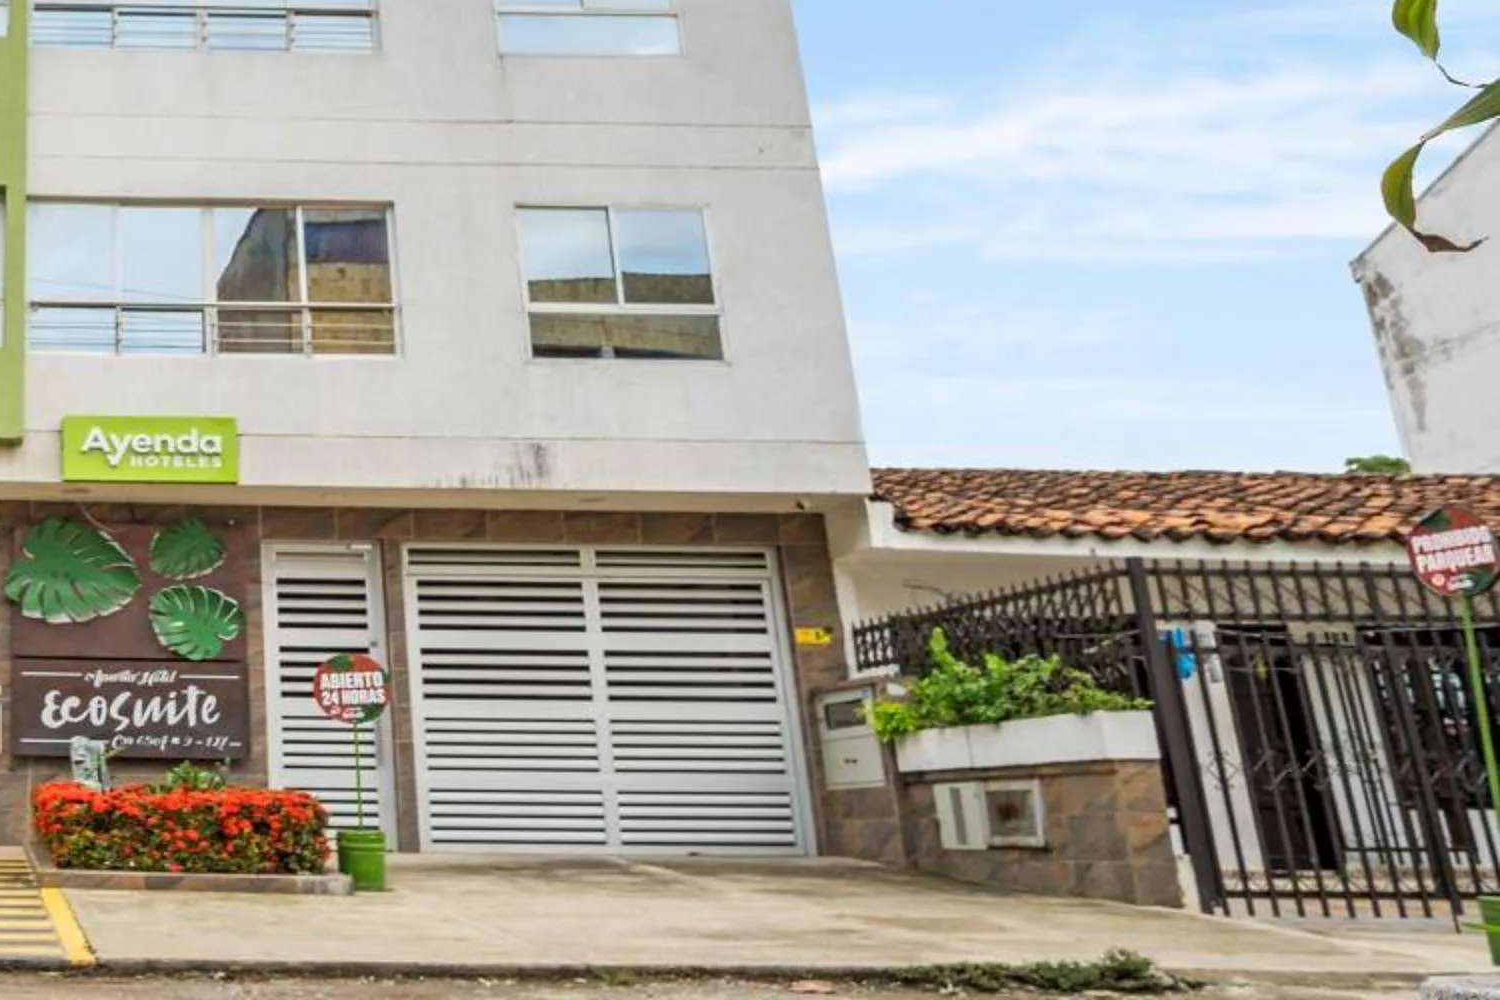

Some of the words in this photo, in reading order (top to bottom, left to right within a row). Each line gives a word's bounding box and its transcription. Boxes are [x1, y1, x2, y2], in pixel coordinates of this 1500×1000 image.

[82, 427, 222, 466] Ayenda
[130, 456, 222, 468] HOTELES
[1415, 544, 1496, 574] PARQUEAR
[320, 672, 384, 690] ABIERTO
[321, 690, 339, 706] 24
[341, 688, 386, 705] HORAS
